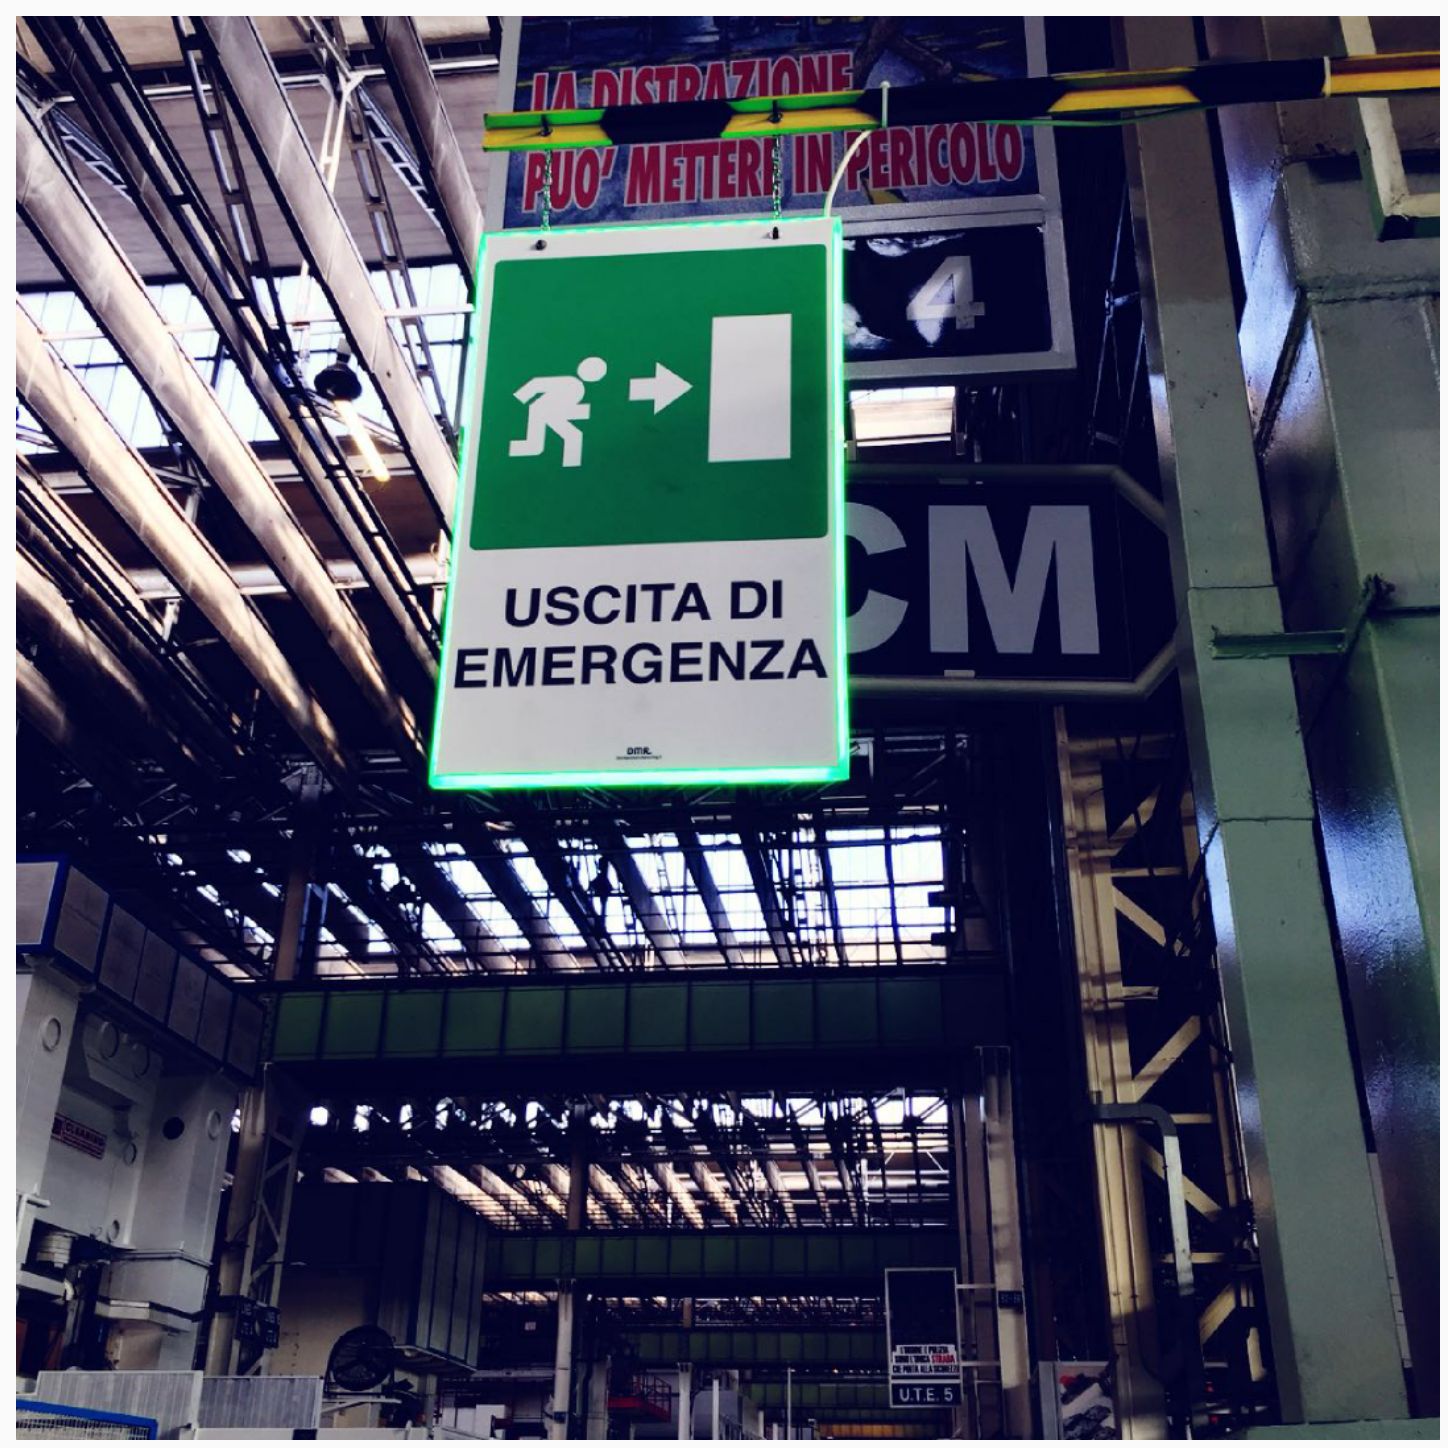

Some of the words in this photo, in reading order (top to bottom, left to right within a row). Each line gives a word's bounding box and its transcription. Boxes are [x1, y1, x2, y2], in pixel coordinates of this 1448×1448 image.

[591, 51, 853, 108] DISTRAZIONE
[522, 146, 618, 213] PUO'
[793, 131, 835, 195] IN
[845, 120, 1025, 191] PERICOLO
[906, 255, 985, 330] 4
[504, 582, 712, 627] USCITA
[730, 579, 783, 620] DI
[453, 638, 829, 689] EMERGENZA
[899, 1387, 940, 1403] U.T.E.
[943, 1387, 954, 1403] 5
